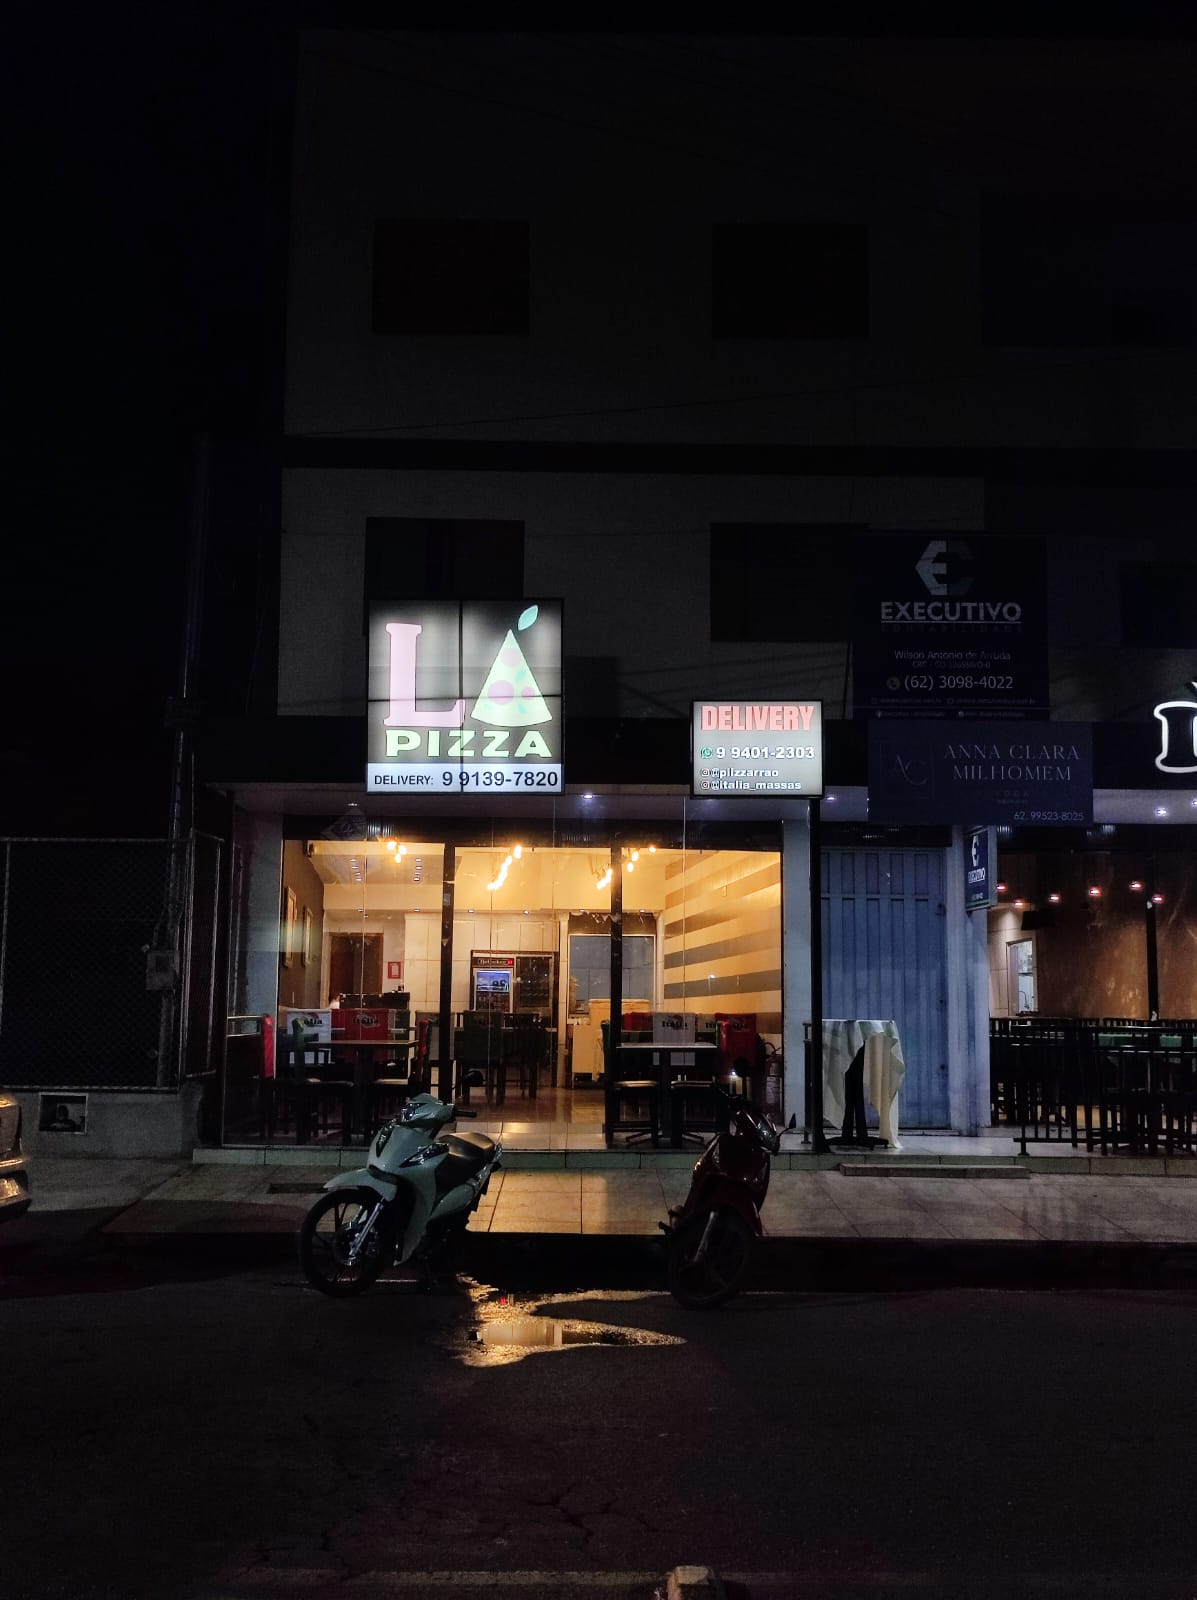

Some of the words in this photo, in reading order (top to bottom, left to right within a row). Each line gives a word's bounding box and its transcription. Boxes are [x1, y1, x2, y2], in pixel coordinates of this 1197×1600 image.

[881, 602, 1022, 621] EXECUTIVO
[895, 650, 925, 660] Wilson
[904, 674, 934, 692] (62)
[938, 675, 1014, 689] 3098-4022
[701, 705, 815, 731] DELIVERY
[385, 729, 552, 758] PIZZA
[716, 747, 726, 759] 9
[731, 747, 815, 759] 9401-2303
[944, 744, 1001, 760] ANNA
[1009, 744, 1081, 760] CLARA
[374, 775, 434, 786] DELIVERY:
[442, 772, 454, 786] 9
[459, 771, 558, 787] 9139-7820
[953, 766, 1072, 781] MILHOMEM
